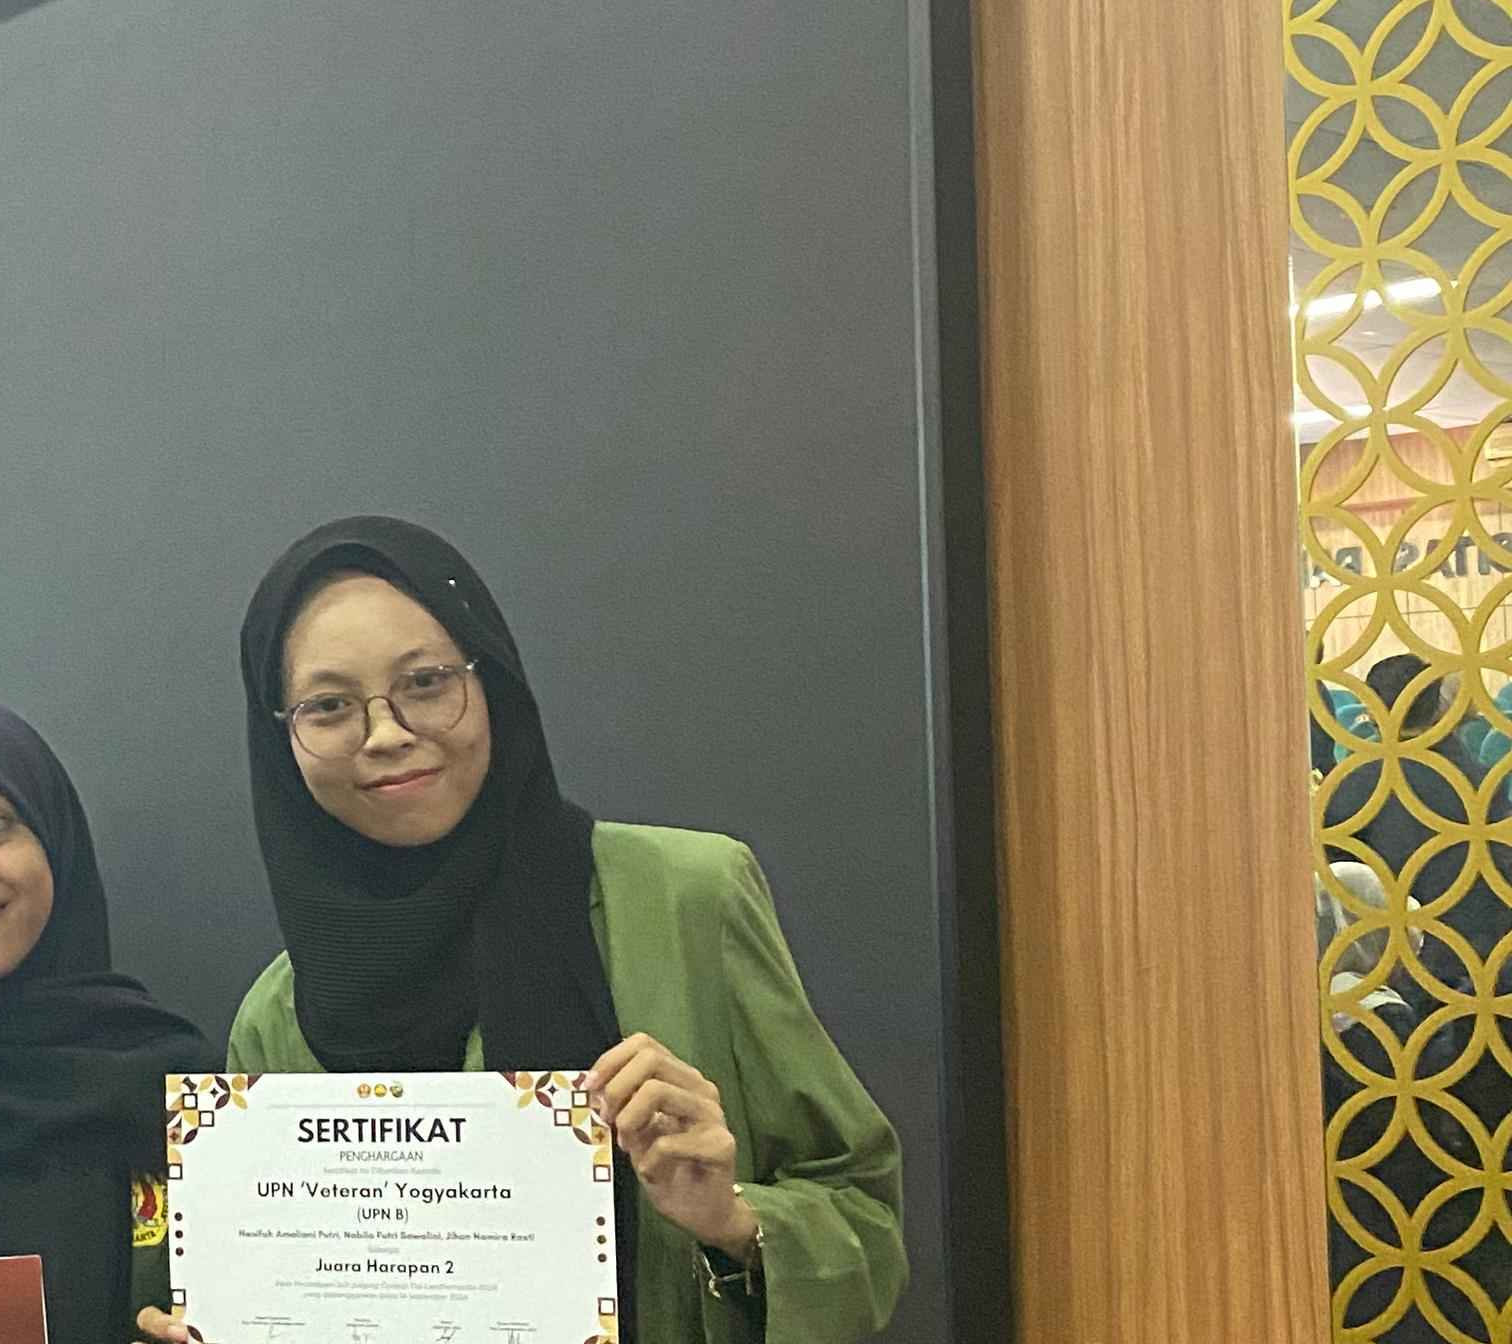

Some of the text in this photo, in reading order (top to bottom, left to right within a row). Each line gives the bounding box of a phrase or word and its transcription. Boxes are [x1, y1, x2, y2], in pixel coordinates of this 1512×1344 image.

[297, 1117, 467, 1143] SERTIFIKAT
[339, 1150, 424, 1162] PENGHARGAAN
[257, 1181, 294, 1198] UPN
[395, 1181, 512, 1204] Yogyakarta
[357, 1208, 409, 1224] (UPN B)
[315, 1258, 455, 1278] Juara Harapan 2
